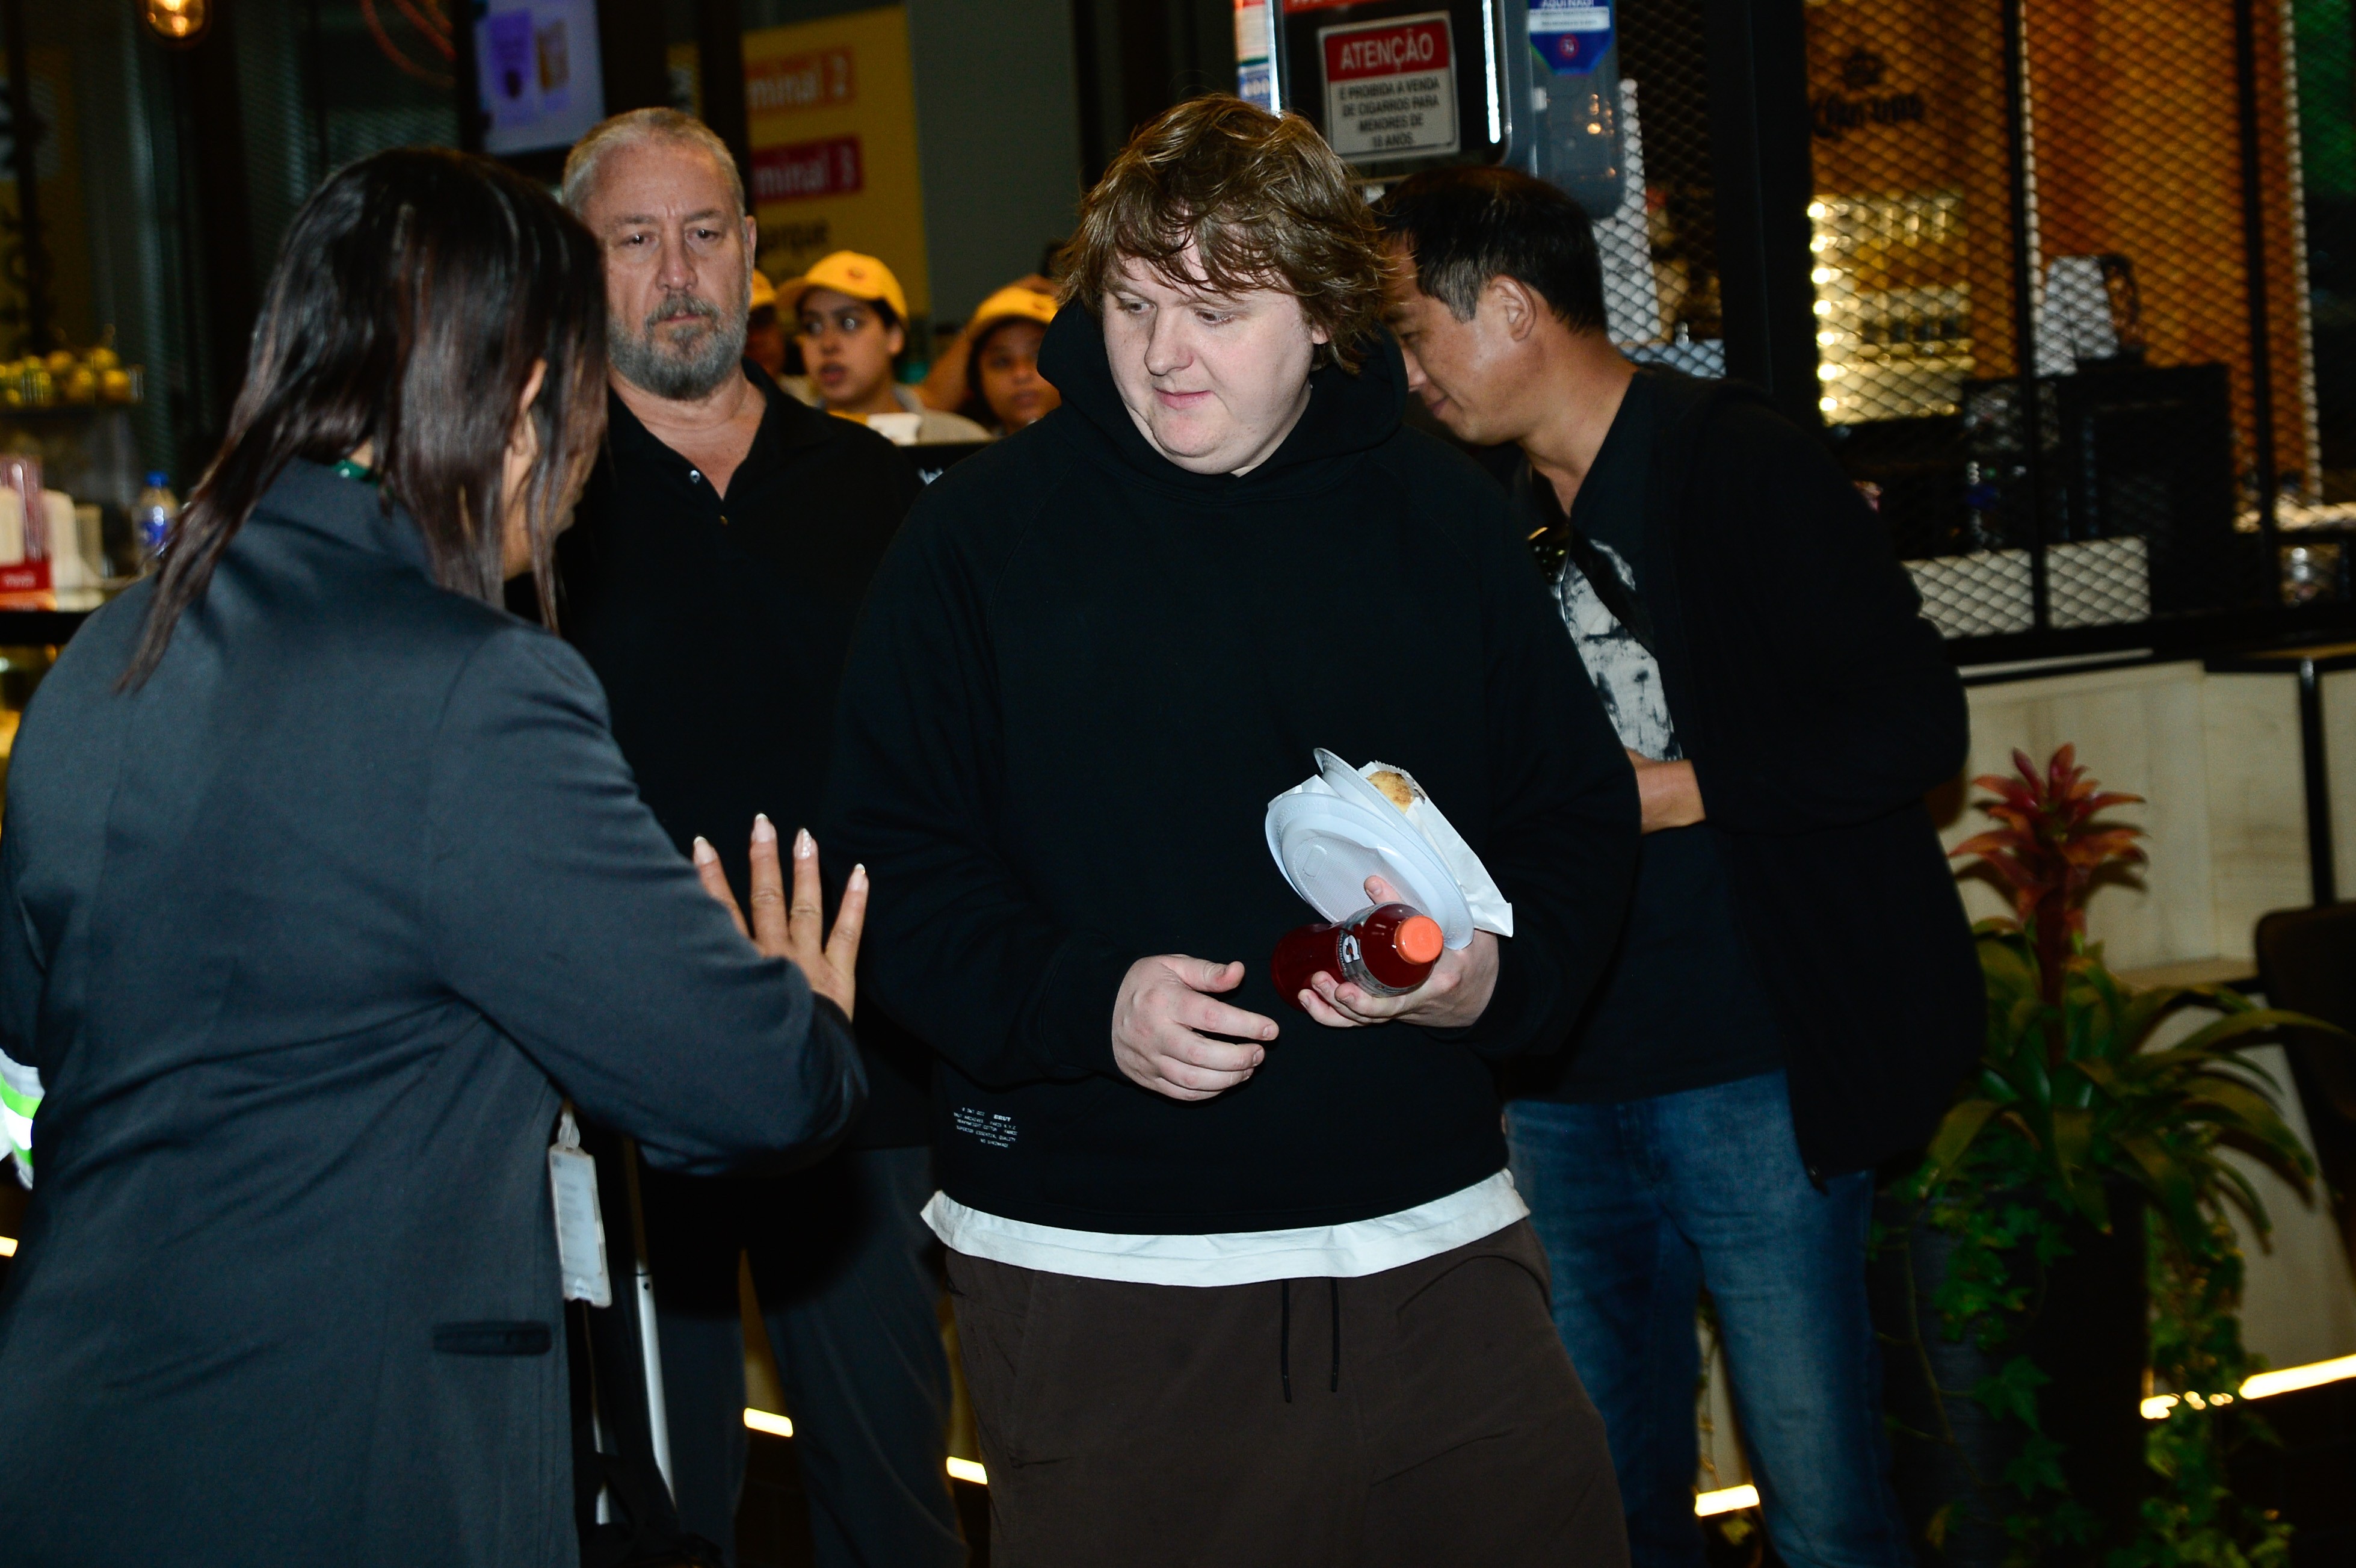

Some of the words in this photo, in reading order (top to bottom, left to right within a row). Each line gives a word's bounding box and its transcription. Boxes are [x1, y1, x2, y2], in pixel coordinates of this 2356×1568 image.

[1340, 28, 1434, 72] ATENÇÃO
[1348, 82, 1395, 99] PROIBIDA
[1396, 81, 1404, 92] A
[1405, 76, 1440, 92] VENDA
[1342, 104, 1354, 117] DE
[1358, 97, 1410, 116] CIGARROS
[1411, 94, 1440, 108] PARA
[1358, 115, 1409, 132] MENORES
[1410, 113, 1423, 126] DE
[1385, 132, 1413, 146] ANOS
